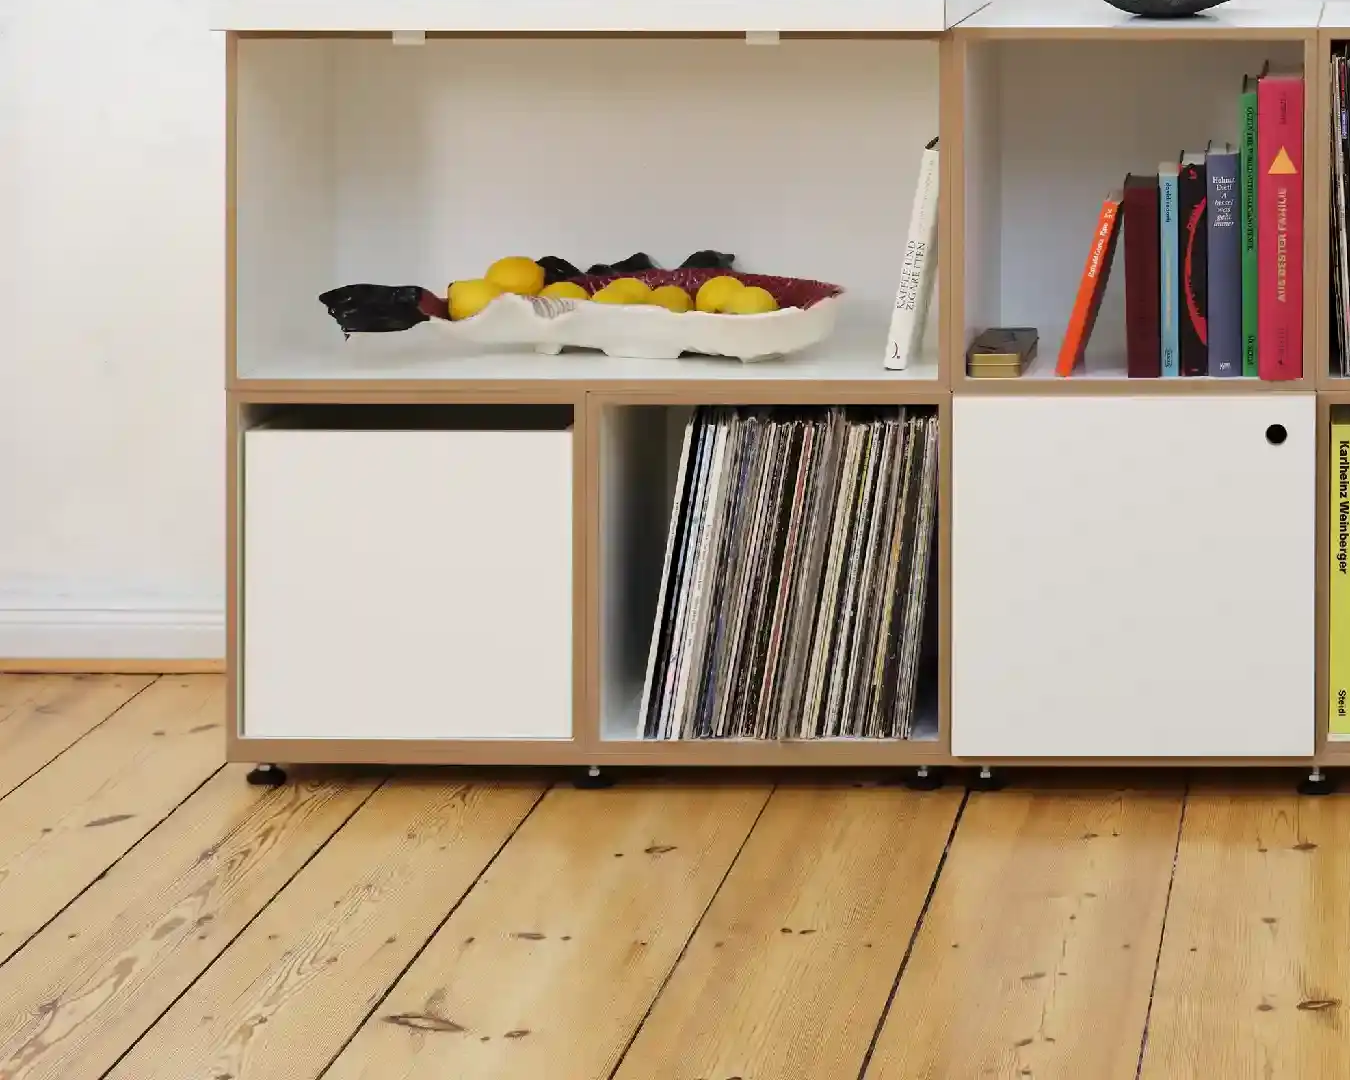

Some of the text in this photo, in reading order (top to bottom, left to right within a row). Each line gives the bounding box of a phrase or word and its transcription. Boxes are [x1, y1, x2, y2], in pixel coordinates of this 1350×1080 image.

[1278, 234, 1287, 277] BESTER
[1336, 440, 1350, 575] Karlheinz Weinberger
[1338, 689, 1346, 716] Steidl
